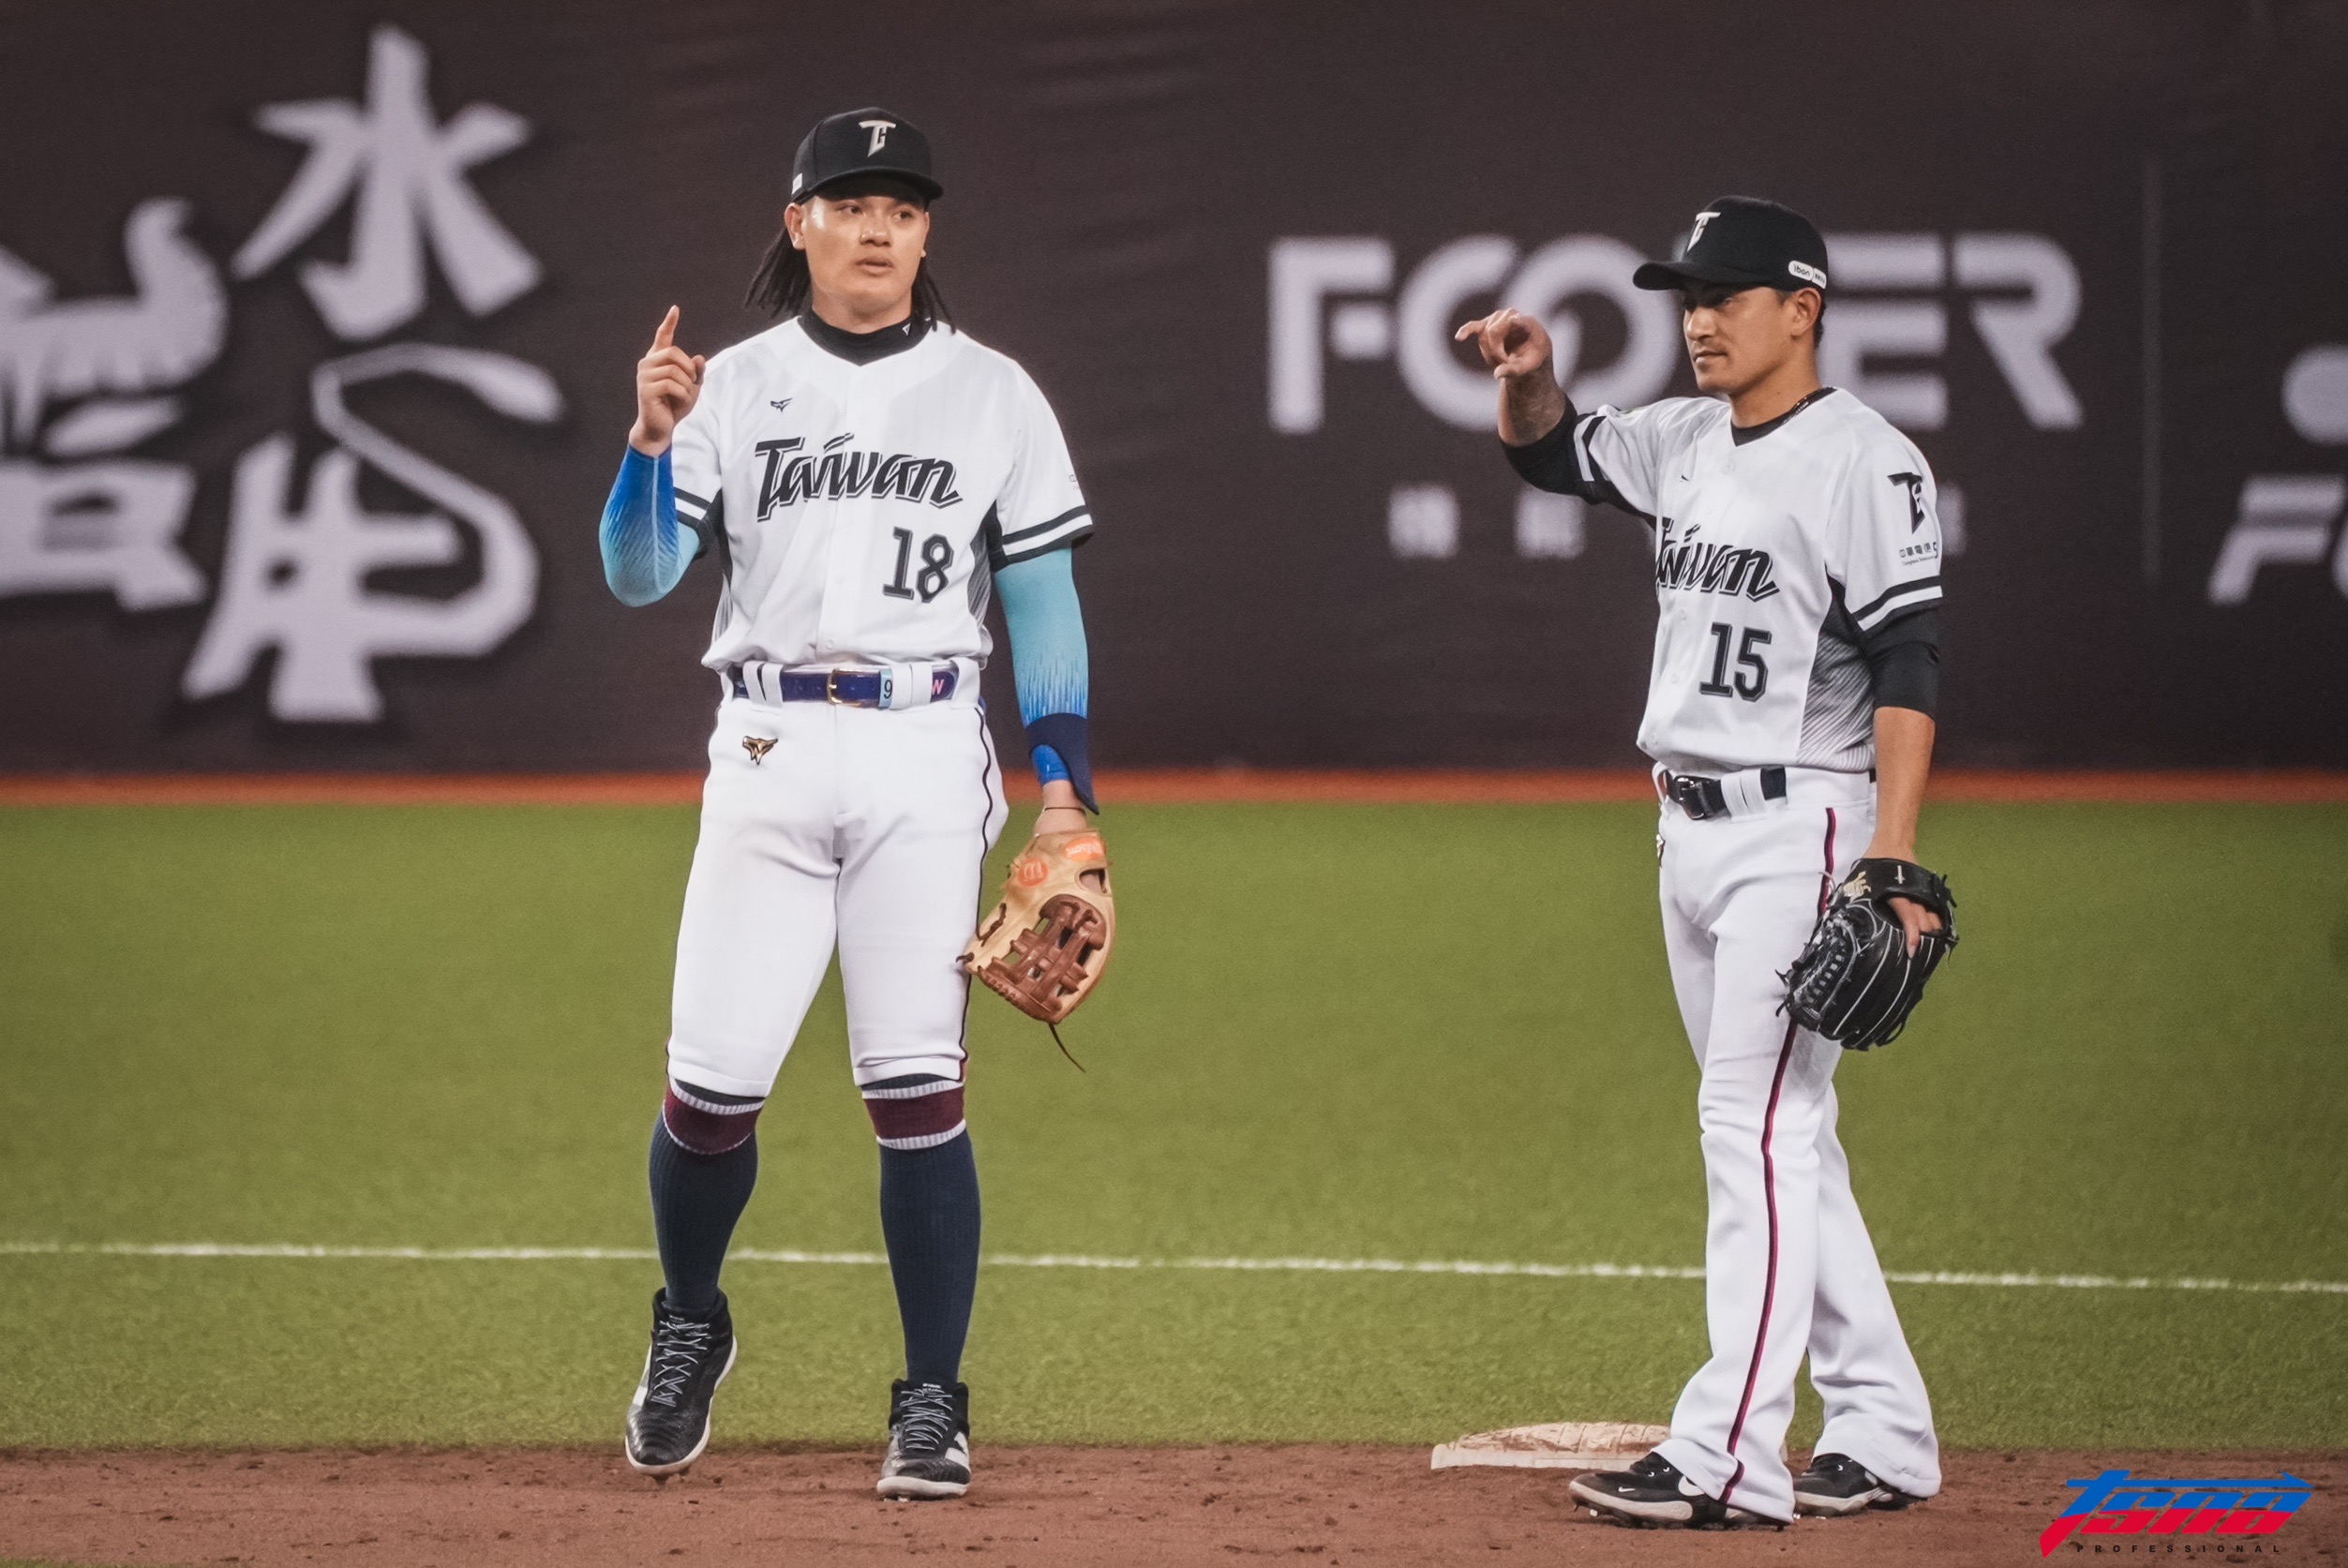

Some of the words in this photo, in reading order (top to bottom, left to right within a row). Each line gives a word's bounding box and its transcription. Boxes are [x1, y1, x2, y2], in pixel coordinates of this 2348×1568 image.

[1267, 233, 2084, 434] FOOER
[755, 432, 964, 523] Taiwan
[882, 526, 954, 603] 18
[884, 679, 892, 698] 9
[1698, 621, 1772, 702] 15
